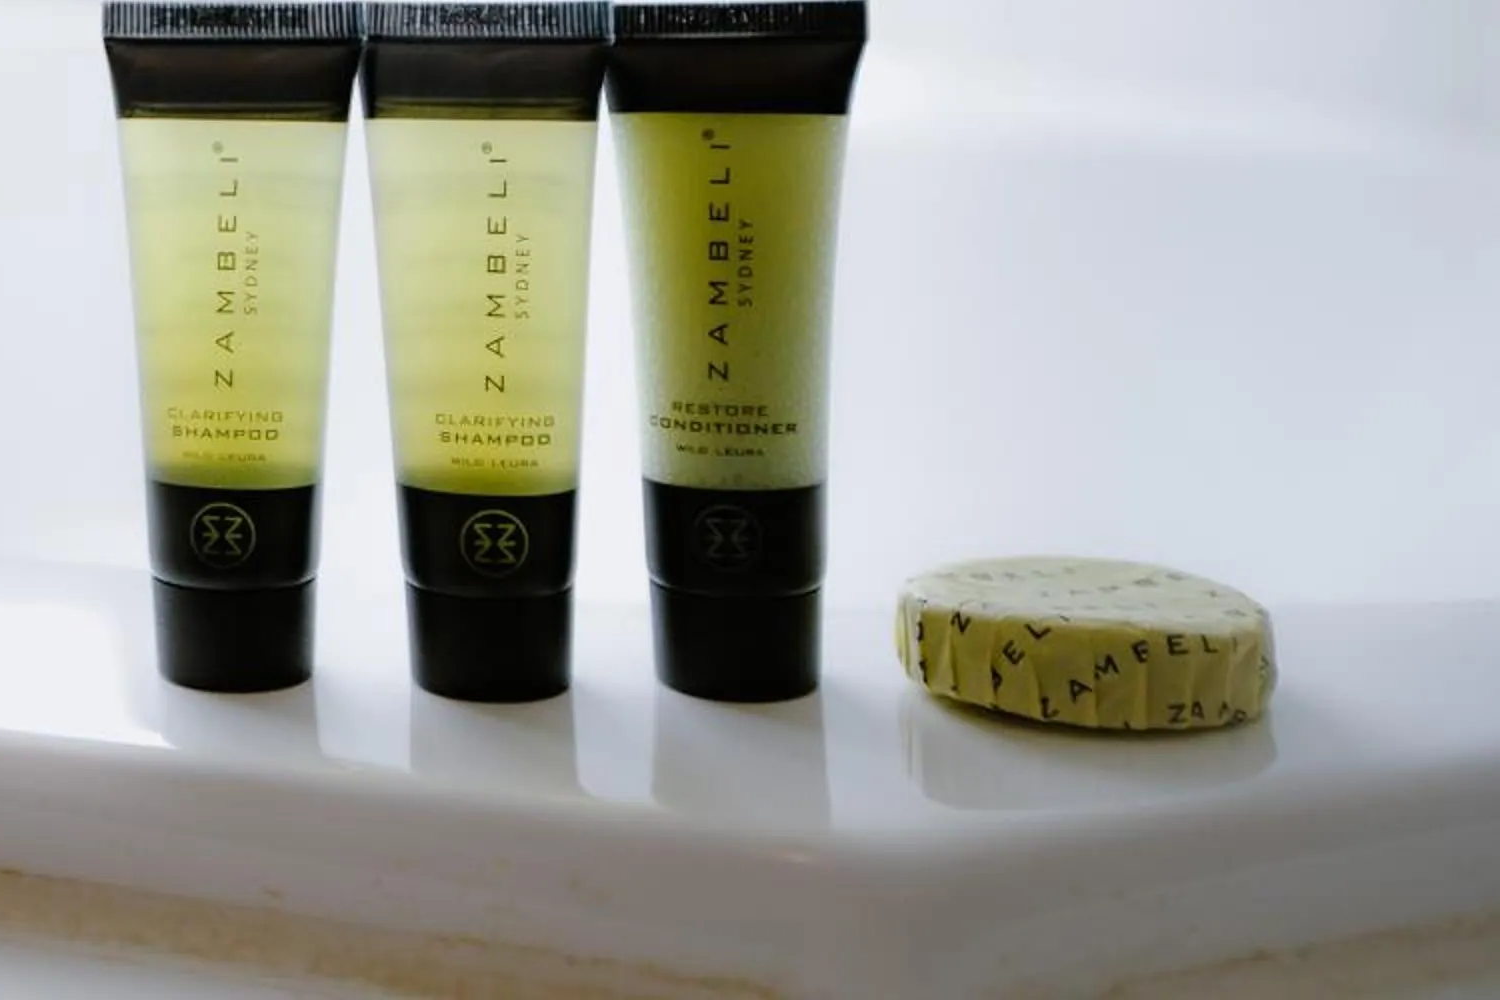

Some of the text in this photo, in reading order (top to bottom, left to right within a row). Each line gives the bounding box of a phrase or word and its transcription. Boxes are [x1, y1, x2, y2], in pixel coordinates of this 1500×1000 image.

[737, 219, 754, 308] SYDNEY
[243, 231, 259, 316] SYDNEY
[514, 234, 530, 319] SYDNEY
[167, 407, 283, 423] CLARIFYING
[672, 401, 769, 417] RESTORE
[435, 413, 555, 428] CLARIFYING
[650, 414, 798, 435] CONDITIONER
[172, 426, 279, 441] SHAMPOO
[439, 431, 551, 446] SHAMPOO
